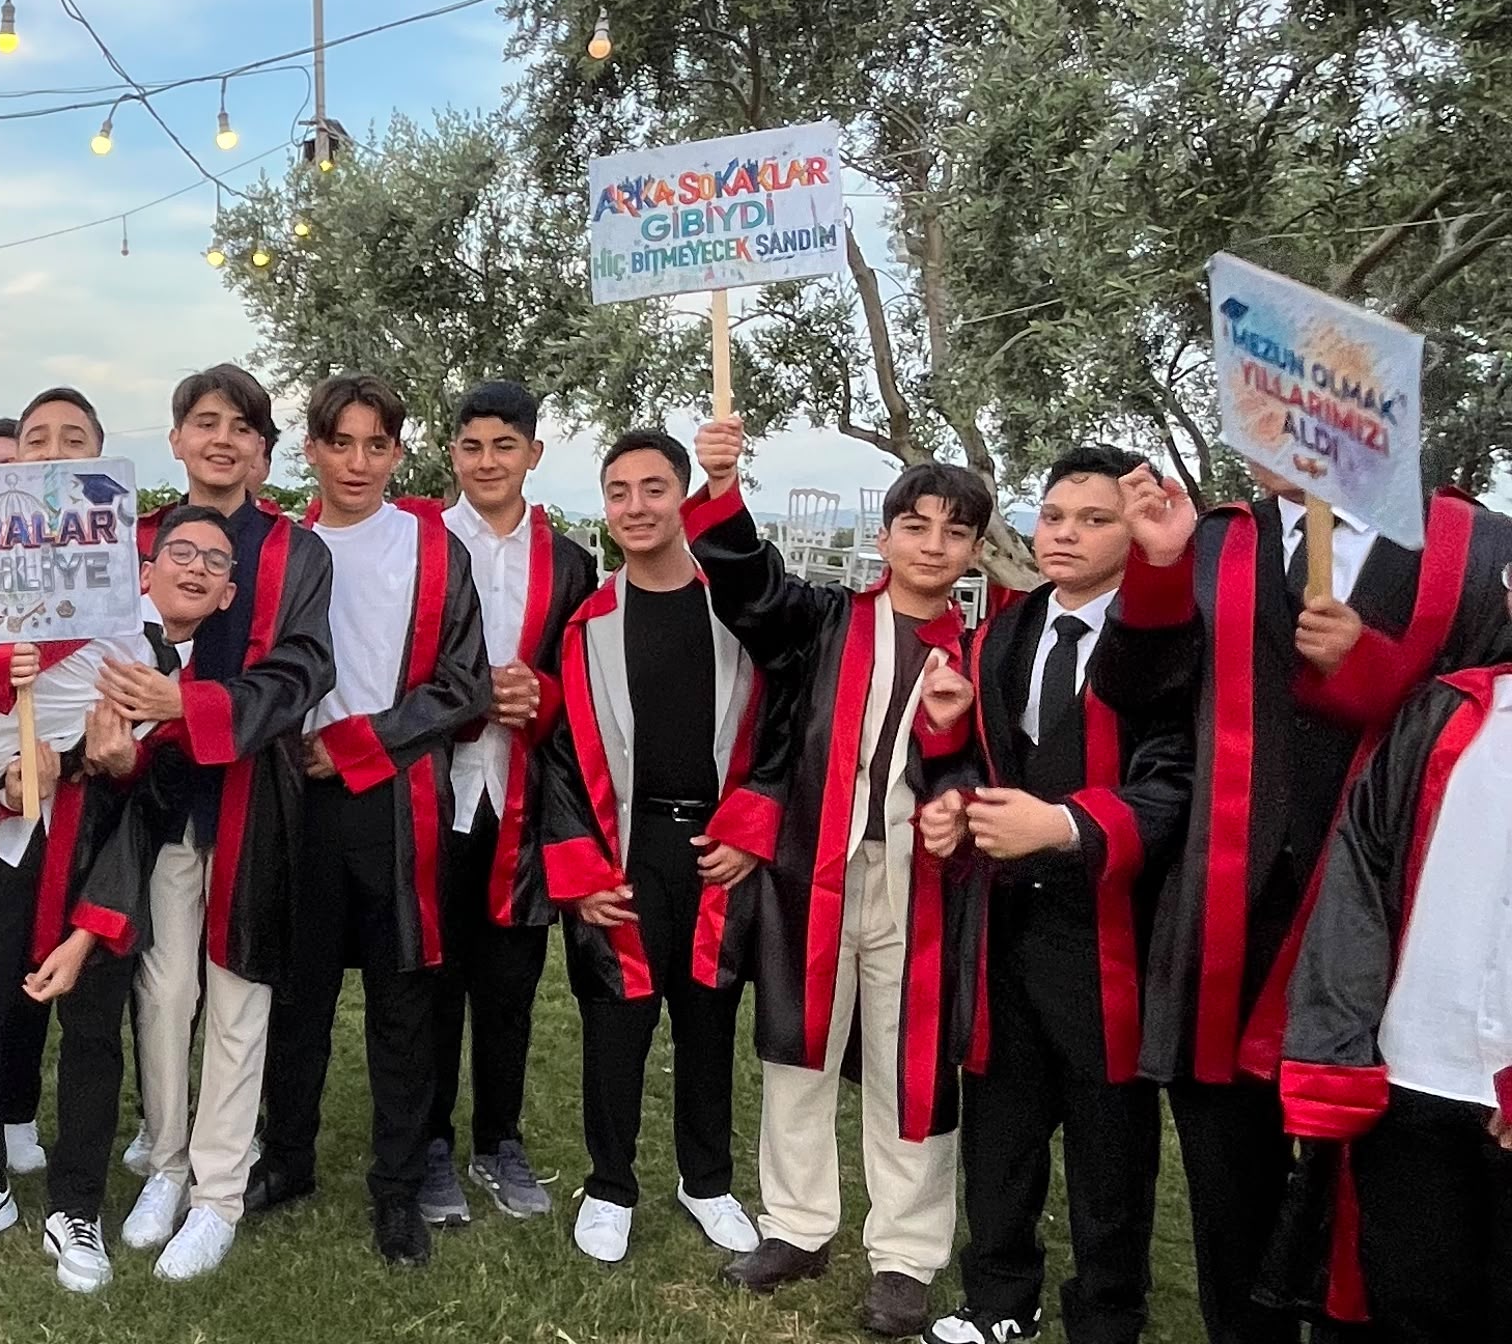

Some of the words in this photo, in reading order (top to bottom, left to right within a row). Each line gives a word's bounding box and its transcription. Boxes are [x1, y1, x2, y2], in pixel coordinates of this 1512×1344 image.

[592, 177, 676, 222] ARKA
[678, 156, 830, 205] SOKAKLAR
[641, 193, 775, 242] GİBİYDİ
[631, 236, 754, 277] BİTMEYECEK
[755, 223, 837, 256] SANDIM
[1241, 358, 1390, 457] YILLARIMIZI
[1312, 362, 1399, 426] OLMAK
[1282, 411, 1339, 463] ALDI
